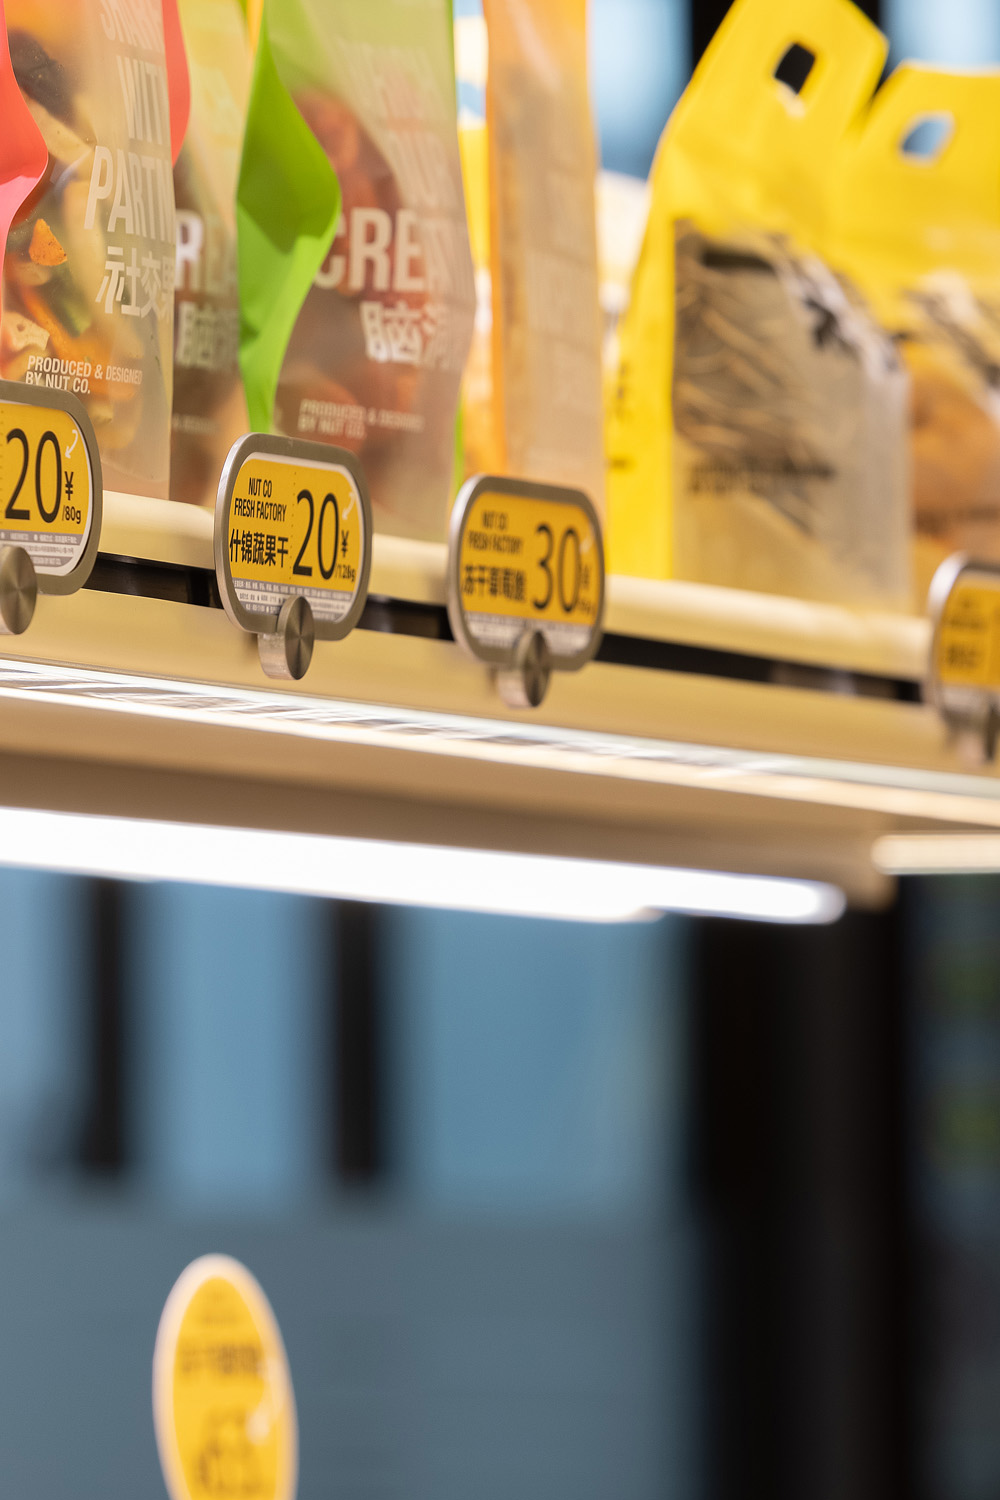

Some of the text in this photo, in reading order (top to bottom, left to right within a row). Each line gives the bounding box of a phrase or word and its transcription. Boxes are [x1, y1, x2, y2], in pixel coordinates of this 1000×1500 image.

[25, 371, 91, 395] BY NUT CO.
[27, 355, 144, 386] PRODUCED & DESIGNED
[4, 427, 63, 524] 20
[248, 477, 273, 498] NUT CO
[233, 498, 288, 523] FRESH FACTORY
[229, 528, 289, 568] 什锦蔬果干
[292, 489, 340, 581] 20
[533, 522, 582, 614] 30
